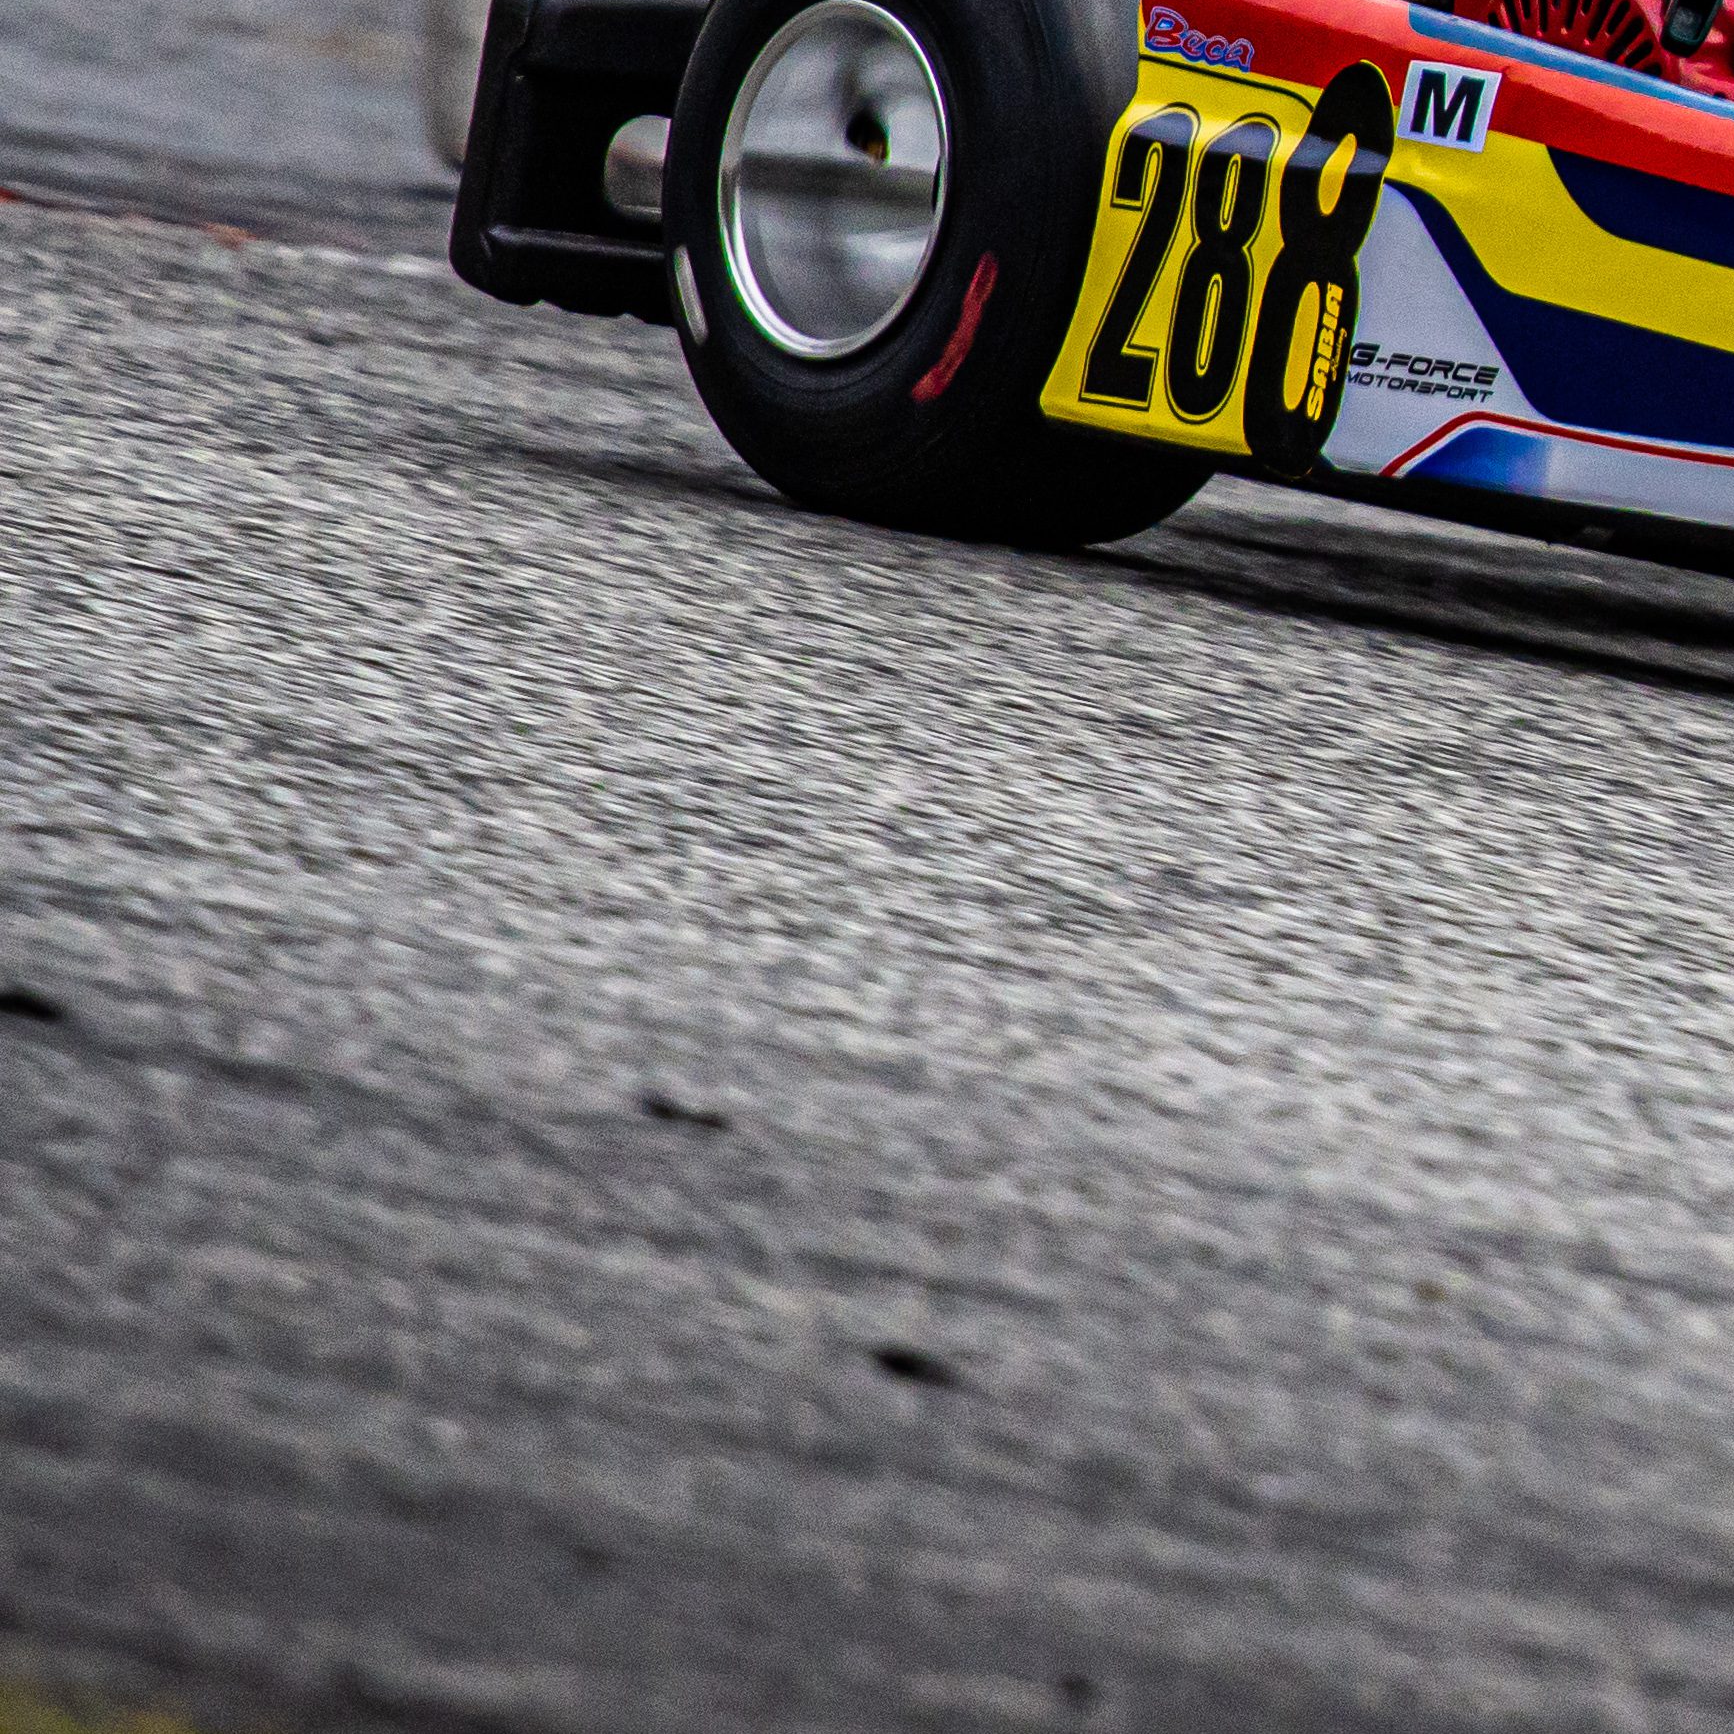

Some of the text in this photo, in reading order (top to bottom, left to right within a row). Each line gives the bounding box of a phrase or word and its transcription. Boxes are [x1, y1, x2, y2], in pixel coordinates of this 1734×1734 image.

[1145, 6, 1255, 73] Beca
[1409, 68, 1486, 143] M
[1078, 59, 1396, 478] 288
[1347, 369, 1494, 403] MOTORSPORT
[1350, 341, 1500, 387] G-FORCE
